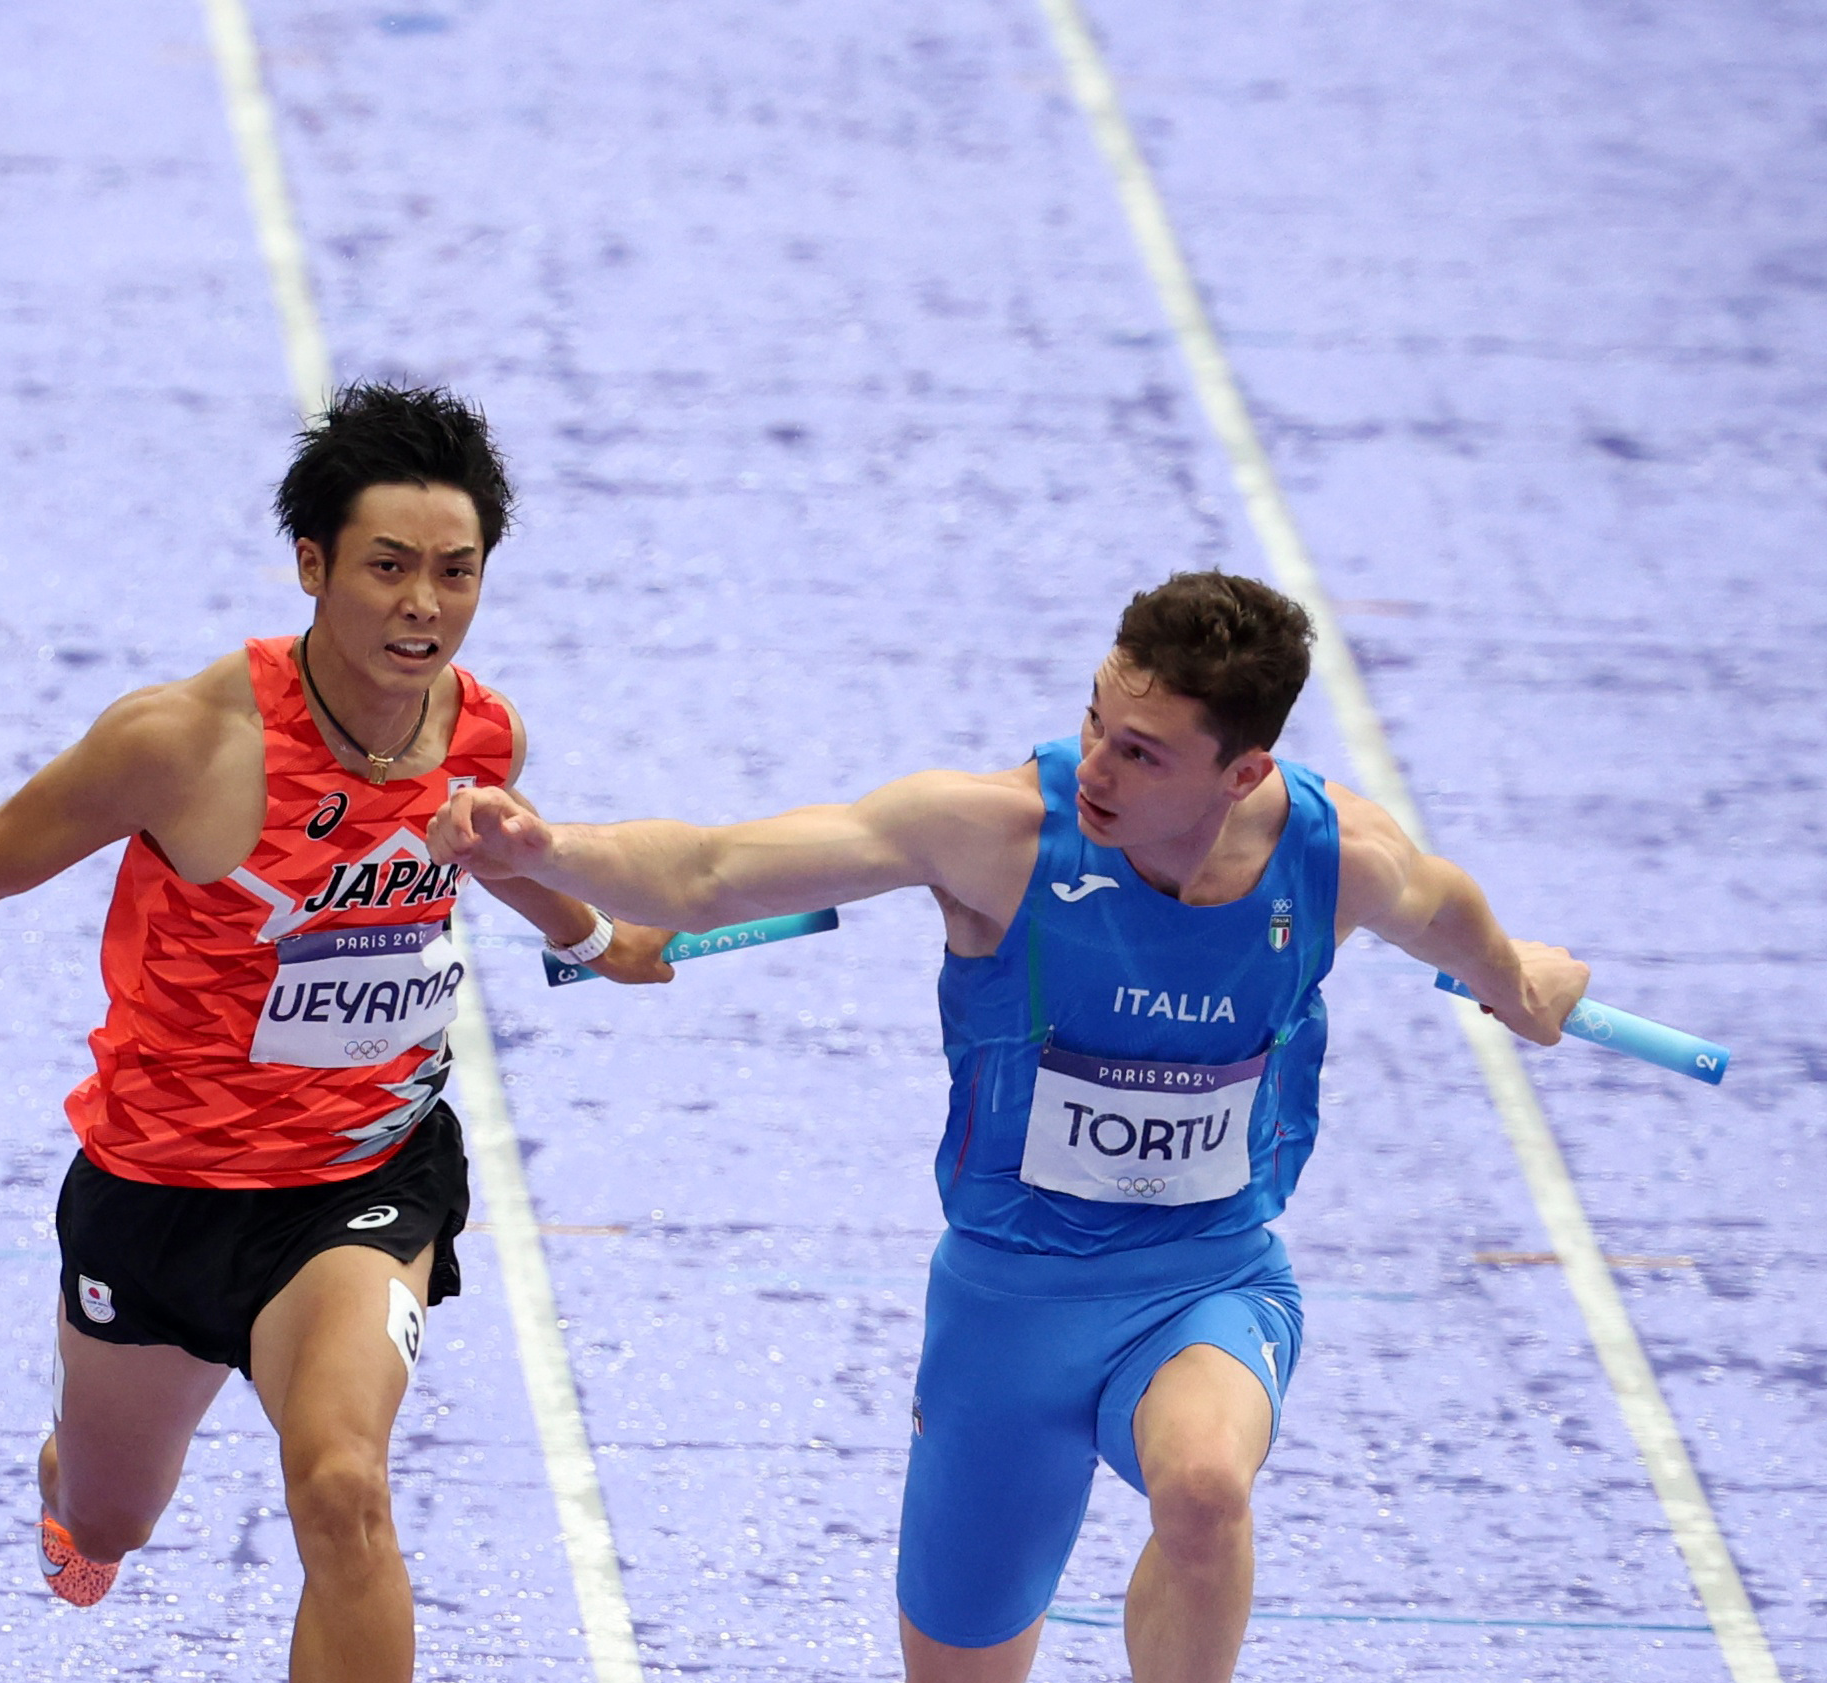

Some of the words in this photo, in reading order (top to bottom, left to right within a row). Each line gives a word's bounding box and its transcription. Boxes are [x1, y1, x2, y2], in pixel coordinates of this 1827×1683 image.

[336, 935, 387, 950] PARIS
[700, 929, 767, 954] 2024
[557, 968, 579, 983] 3
[268, 961, 465, 1024] UEYAMA
[1113, 986, 1236, 1023] ITALIA
[1696, 1053, 1718, 1071] 2
[1099, 1066, 1156, 1084] PARIS
[1163, 1071, 1216, 1086] 2024
[1063, 1101, 1231, 1161] TORTU
[405, 1310, 420, 1362] 3
